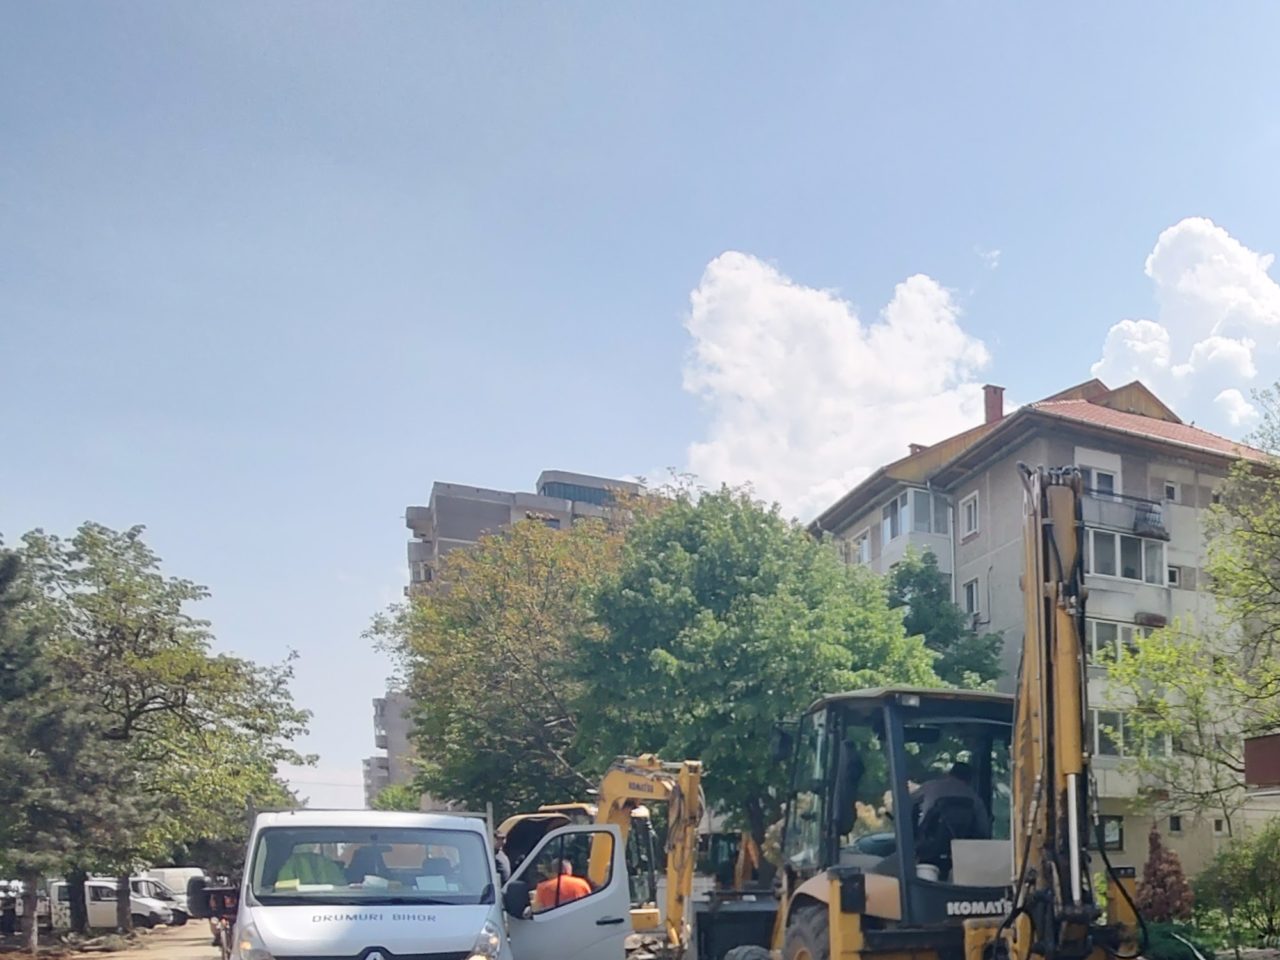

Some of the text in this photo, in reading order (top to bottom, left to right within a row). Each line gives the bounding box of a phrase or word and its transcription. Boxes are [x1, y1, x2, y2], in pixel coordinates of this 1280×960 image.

[946, 899, 1013, 915] KOMATS
[312, 914, 436, 923] DRUMURI BIHOR
